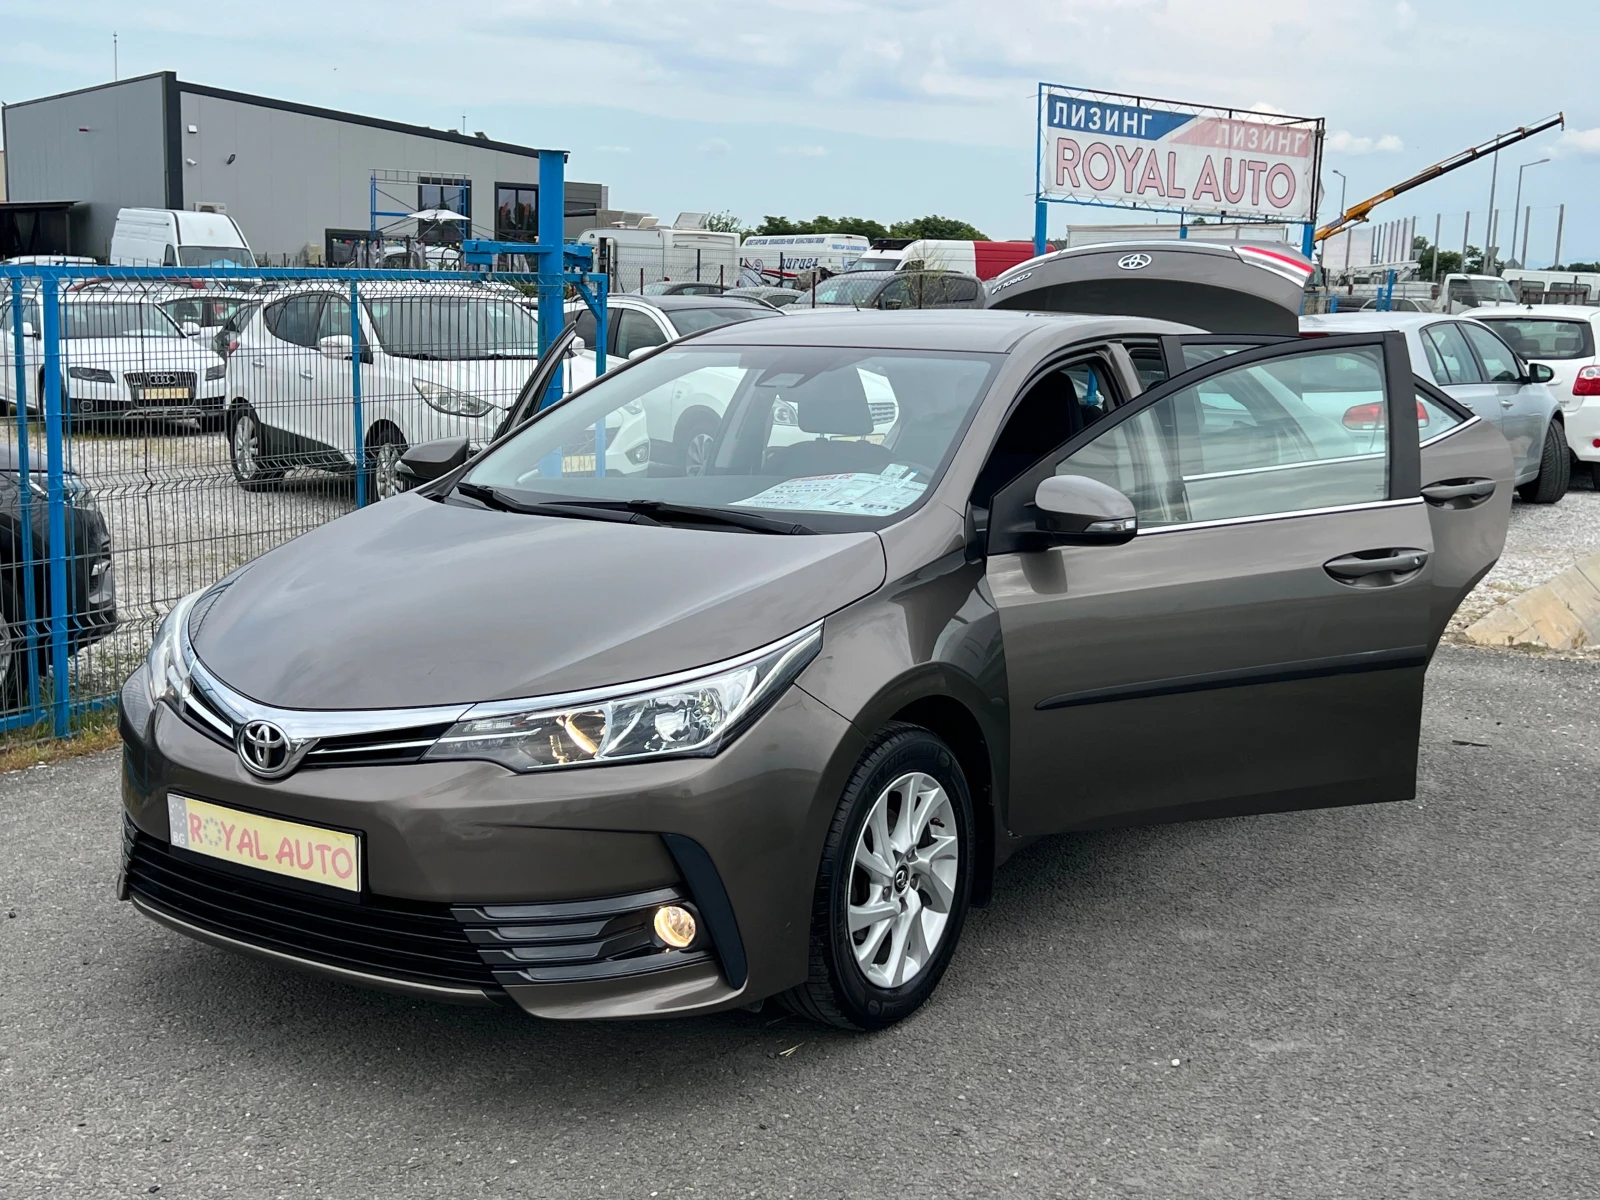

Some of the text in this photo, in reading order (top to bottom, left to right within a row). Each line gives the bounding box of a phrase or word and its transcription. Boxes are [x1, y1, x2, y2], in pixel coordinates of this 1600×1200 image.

[1053, 102, 1152, 136] ЛИЗИНГ
[1215, 124, 1306, 154] ЛИЗИНГ
[1056, 137, 1296, 208] ROYAL AUTO
[991, 272, 1033, 295] COROLLA
[173, 831, 186, 845] BG
[275, 837, 354, 880] AUTO
